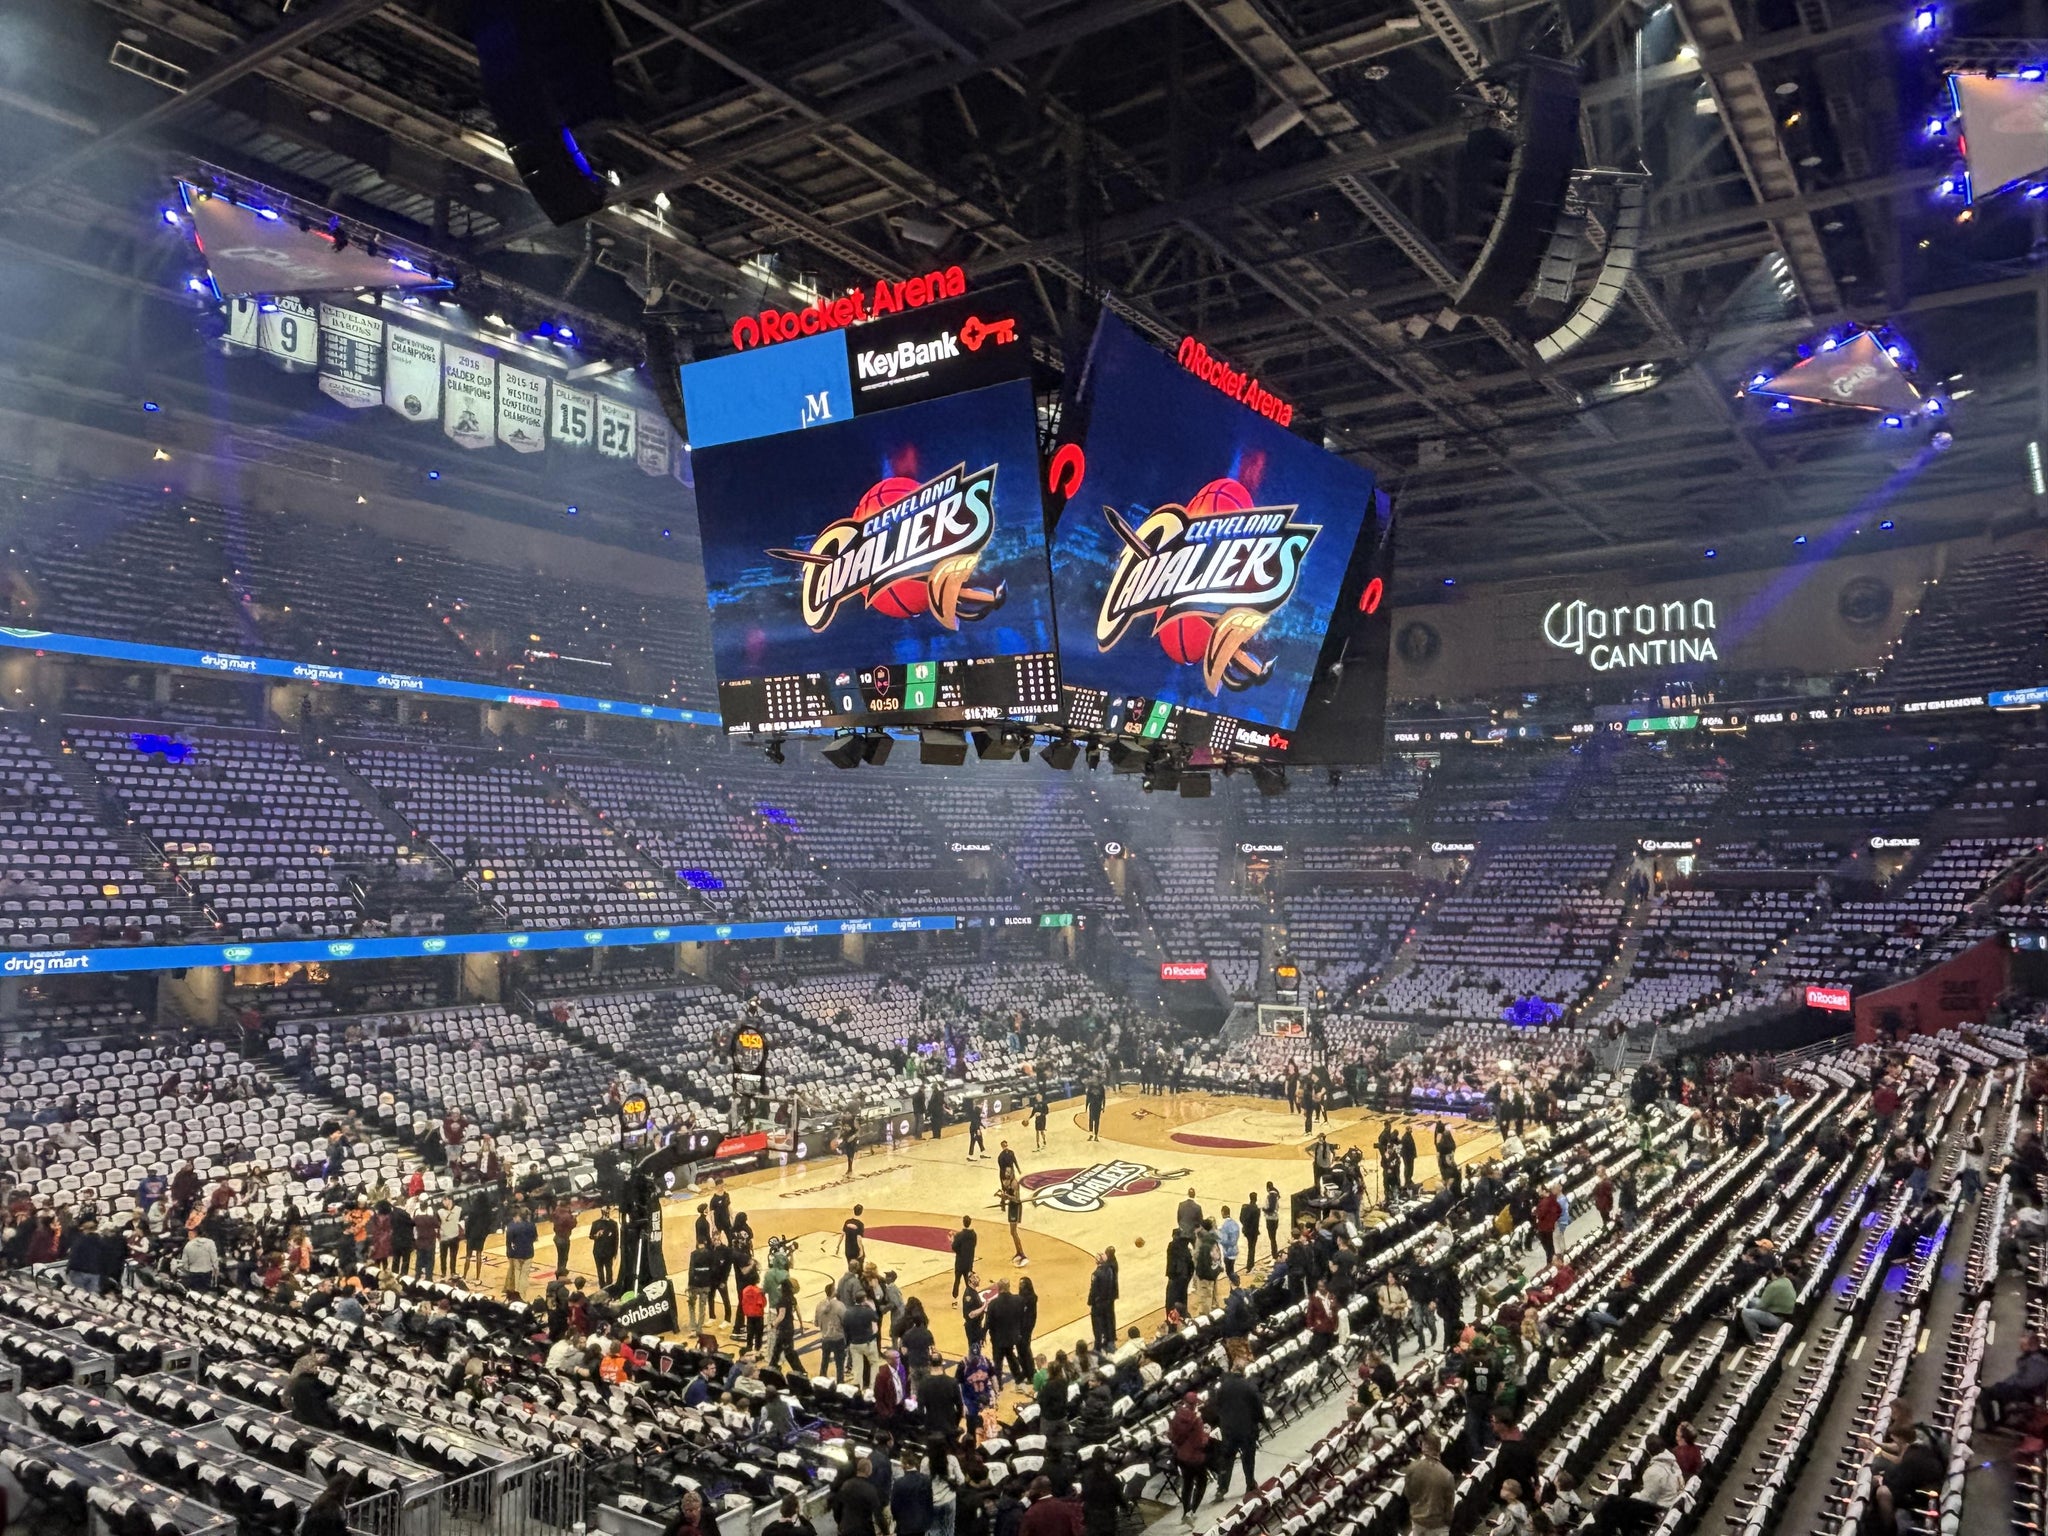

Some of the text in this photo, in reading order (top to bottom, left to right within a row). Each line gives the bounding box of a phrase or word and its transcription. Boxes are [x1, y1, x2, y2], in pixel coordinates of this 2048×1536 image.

[322, 304, 380, 330] CLEVELAND
[760, 265, 966, 344] Rocket Arena
[281, 317, 297, 352] 9
[391, 341, 436, 363] CHAMPIONS
[857, 332, 960, 379] KeyBank
[1190, 342, 1293, 427] Rocket Arena
[560, 403, 587, 439] 15
[602, 418, 630, 452] 27
[863, 475, 957, 537] CLEVELAND
[1184, 513, 1285, 542] CLEVELAND
[802, 480, 990, 627] CAVALIERS
[1097, 512, 1308, 640] CAVALIERS
[1544, 598, 1715, 654] Corona
[201, 654, 228, 669] drug
[229, 658, 257, 670] mart
[1590, 637, 1717, 671] CANTINA
[293, 665, 318, 679] drug
[319, 669, 343, 680] mart
[377, 675, 400, 689] drug
[400, 679, 423, 689] mart
[842, 695, 852, 711] 0
[869, 697, 899, 711] 40:50
[914, 690, 924, 706] 0
[2002, 692, 2026, 704] drug
[1519, 727, 1525, 736] 0
[1755, 714, 1783, 723] FOULS
[4, 955, 89, 974] drug mart
[1173, 966, 1206, 976] Rocket
[1816, 993, 1847, 1006] Rocket
